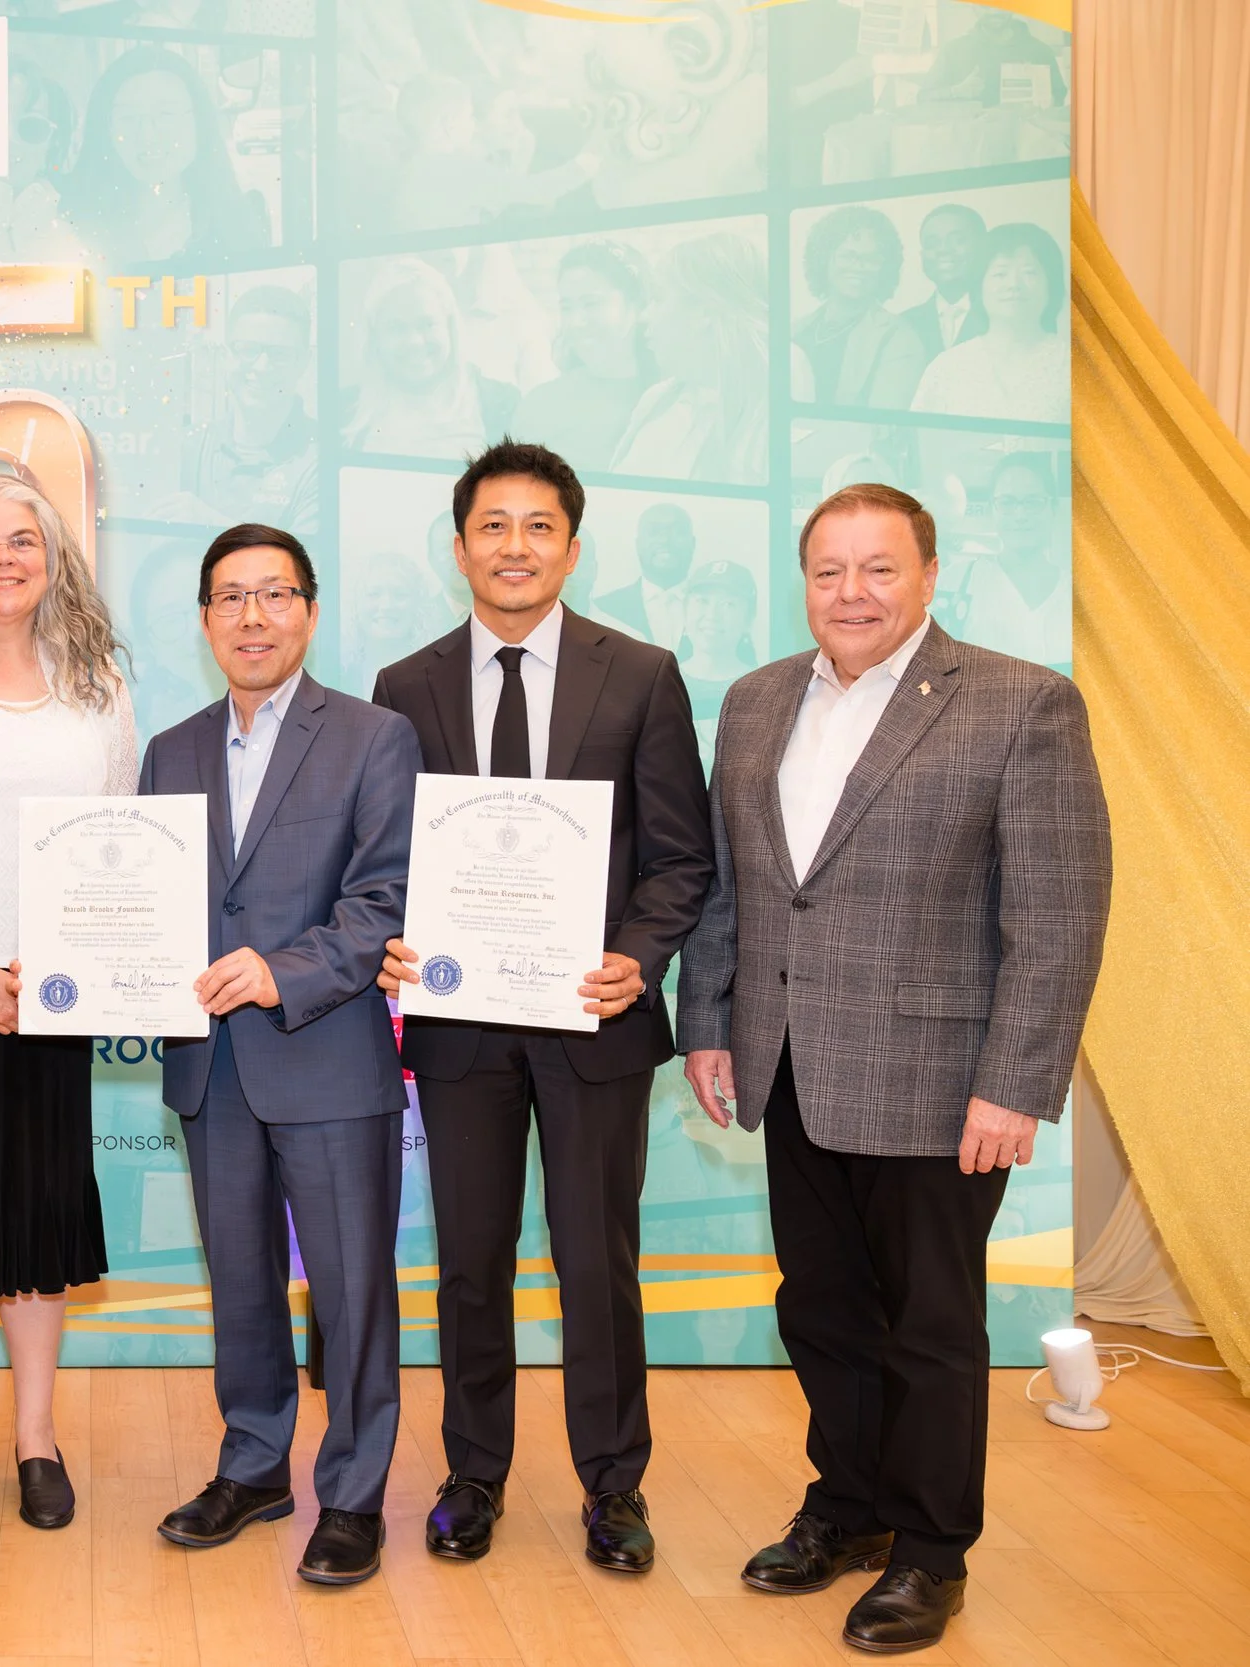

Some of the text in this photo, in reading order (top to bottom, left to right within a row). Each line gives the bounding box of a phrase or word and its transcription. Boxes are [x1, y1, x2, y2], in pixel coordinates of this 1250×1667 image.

[32, 807, 190, 854] The Commonwealth of Massachusetts
[427, 789, 589, 841] The Commonwealth of Massachusetts
[116, 905, 155, 914] Foundation
